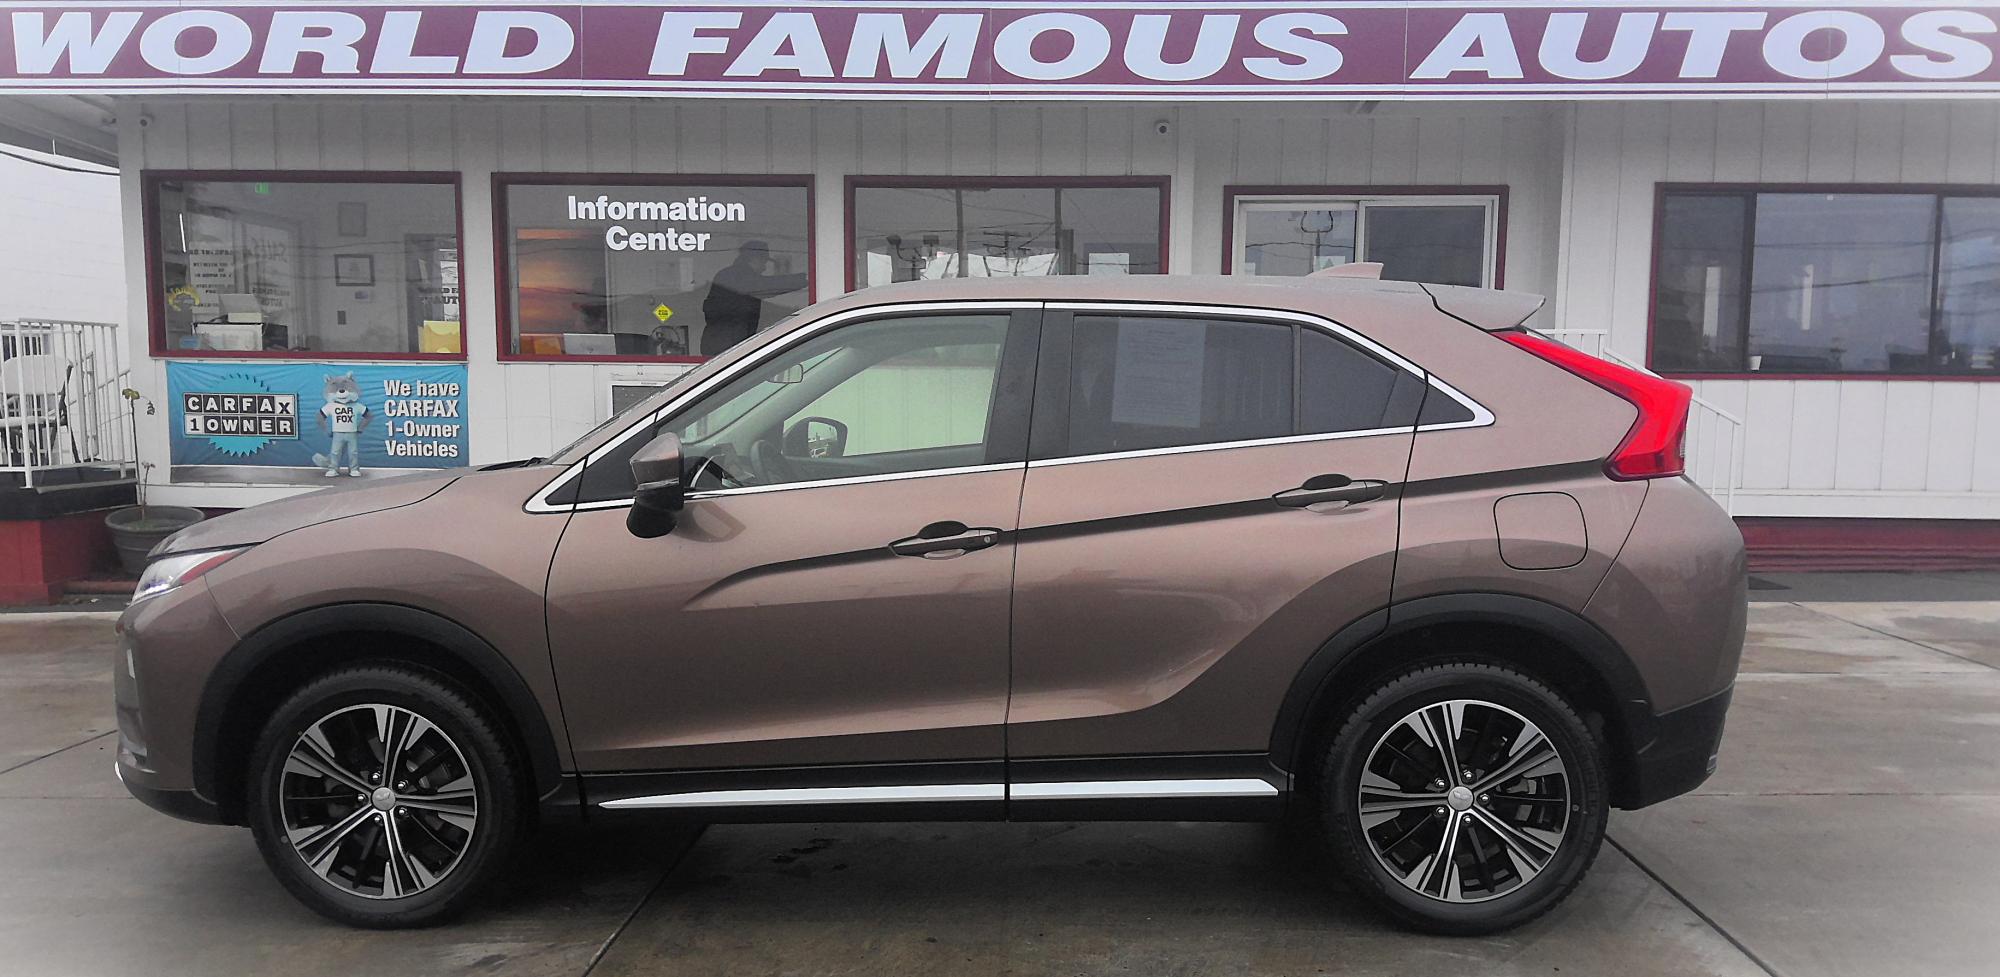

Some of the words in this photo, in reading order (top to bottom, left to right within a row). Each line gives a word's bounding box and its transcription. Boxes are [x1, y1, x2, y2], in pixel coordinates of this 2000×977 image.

[11, 10, 575, 75] WORLD
[647, 12, 1349, 82] FAMOUS
[1409, 10, 1998, 80] AUTOS
[568, 196, 745, 222] Information
[605, 225, 710, 251] Center
[384, 380, 411, 396] We
[416, 380, 460, 396] have
[187, 397, 292, 415] CARFAX
[334, 407, 354, 415] CAR
[384, 400, 460, 418] CARFAX
[336, 415, 353, 424] FOX
[385, 421, 460, 438] 1-Owner
[385, 440, 459, 458] Vehicles
